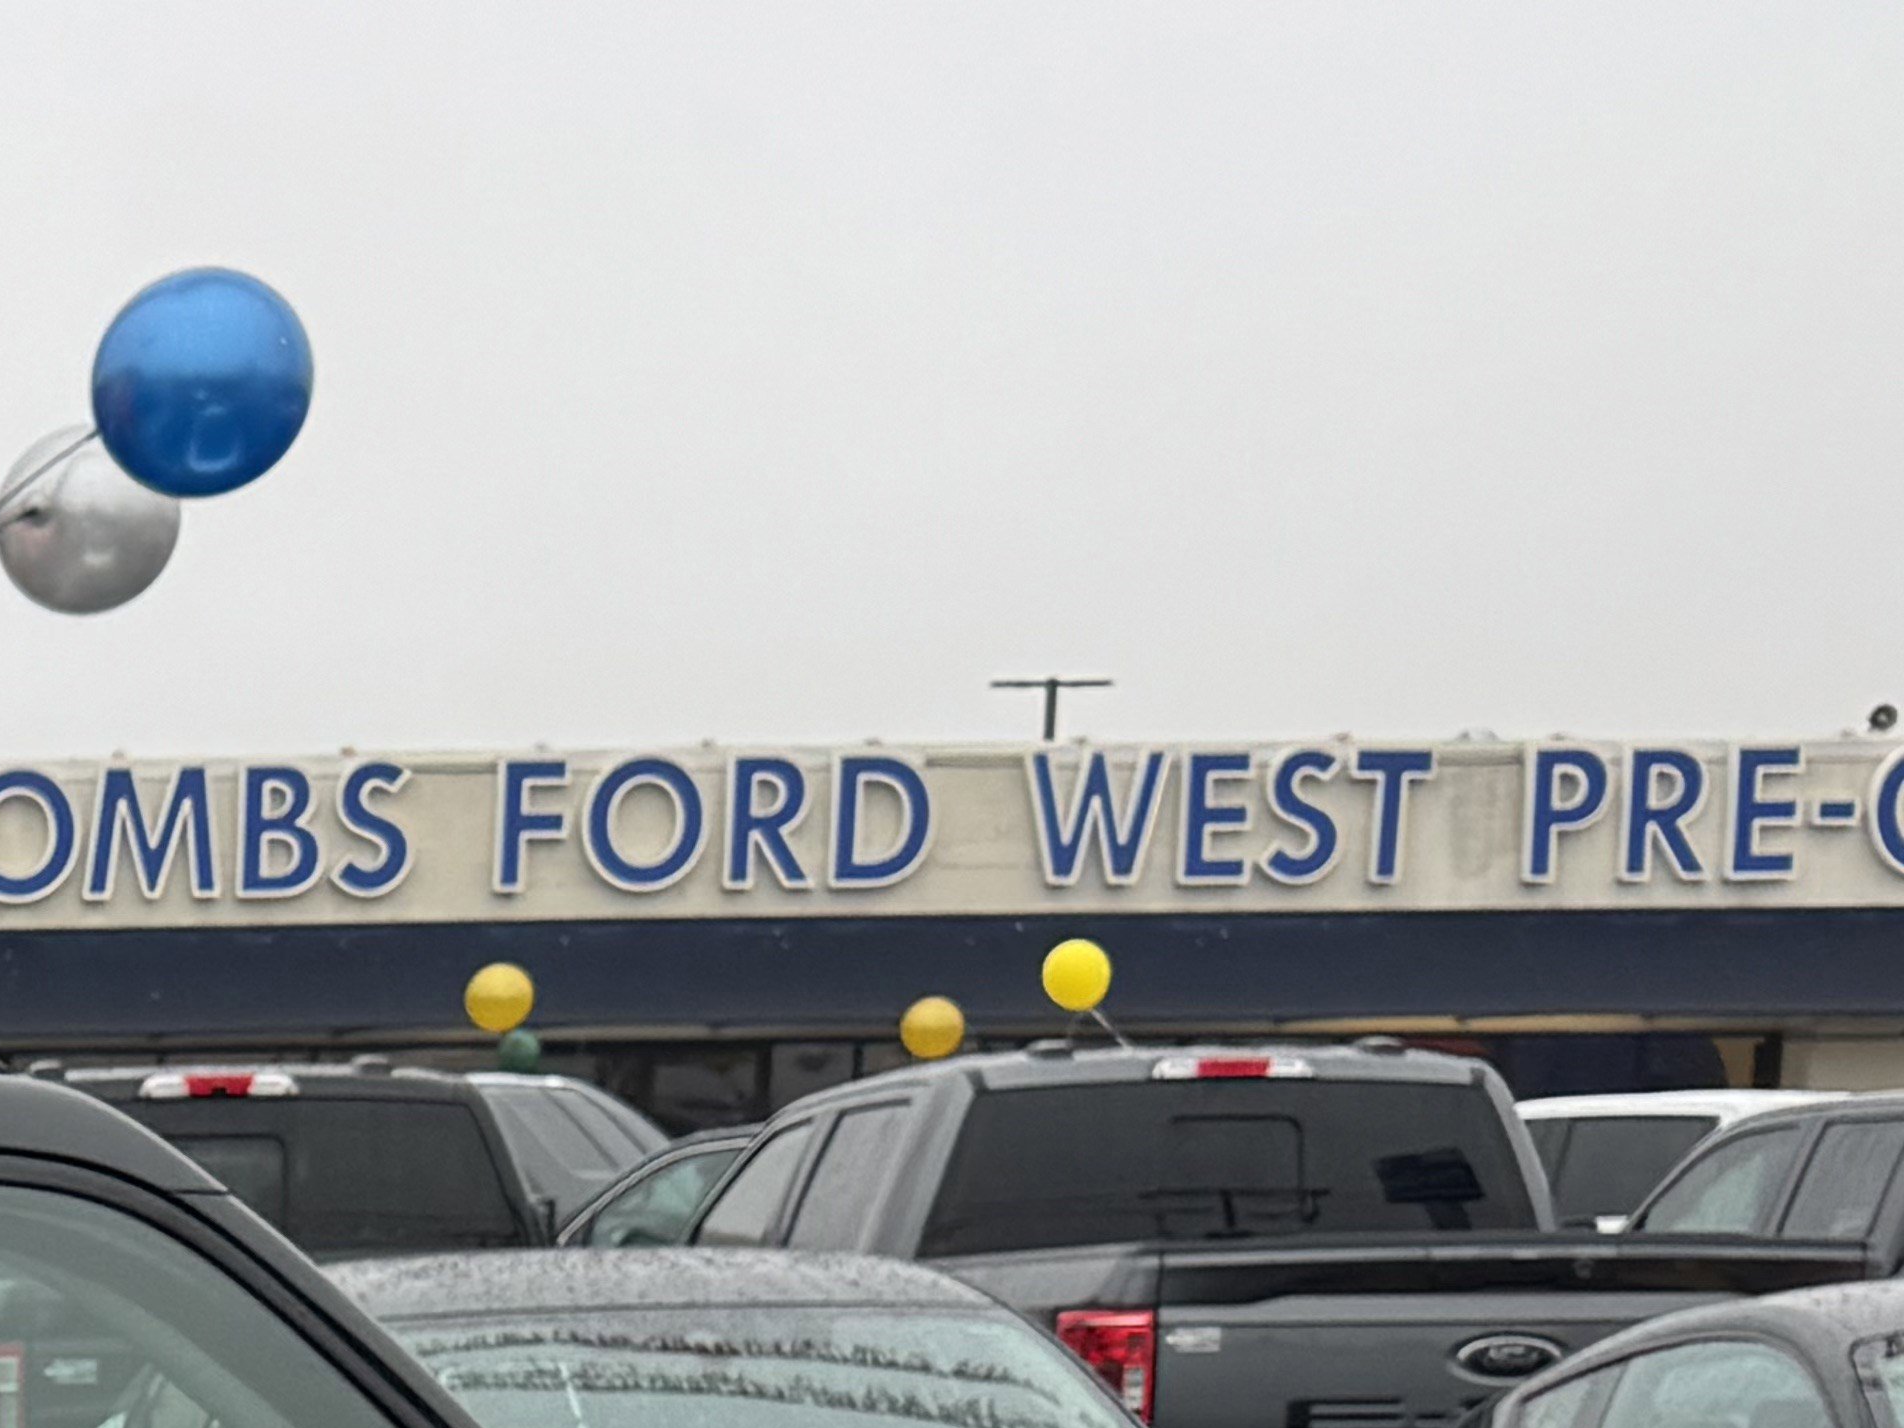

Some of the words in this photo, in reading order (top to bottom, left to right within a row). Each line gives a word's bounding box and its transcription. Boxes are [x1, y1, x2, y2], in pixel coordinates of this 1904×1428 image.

[490, 750, 934, 899] FORD
[1029, 743, 1435, 889] WEST
[1521, 742, 1904, 888] PRE-
